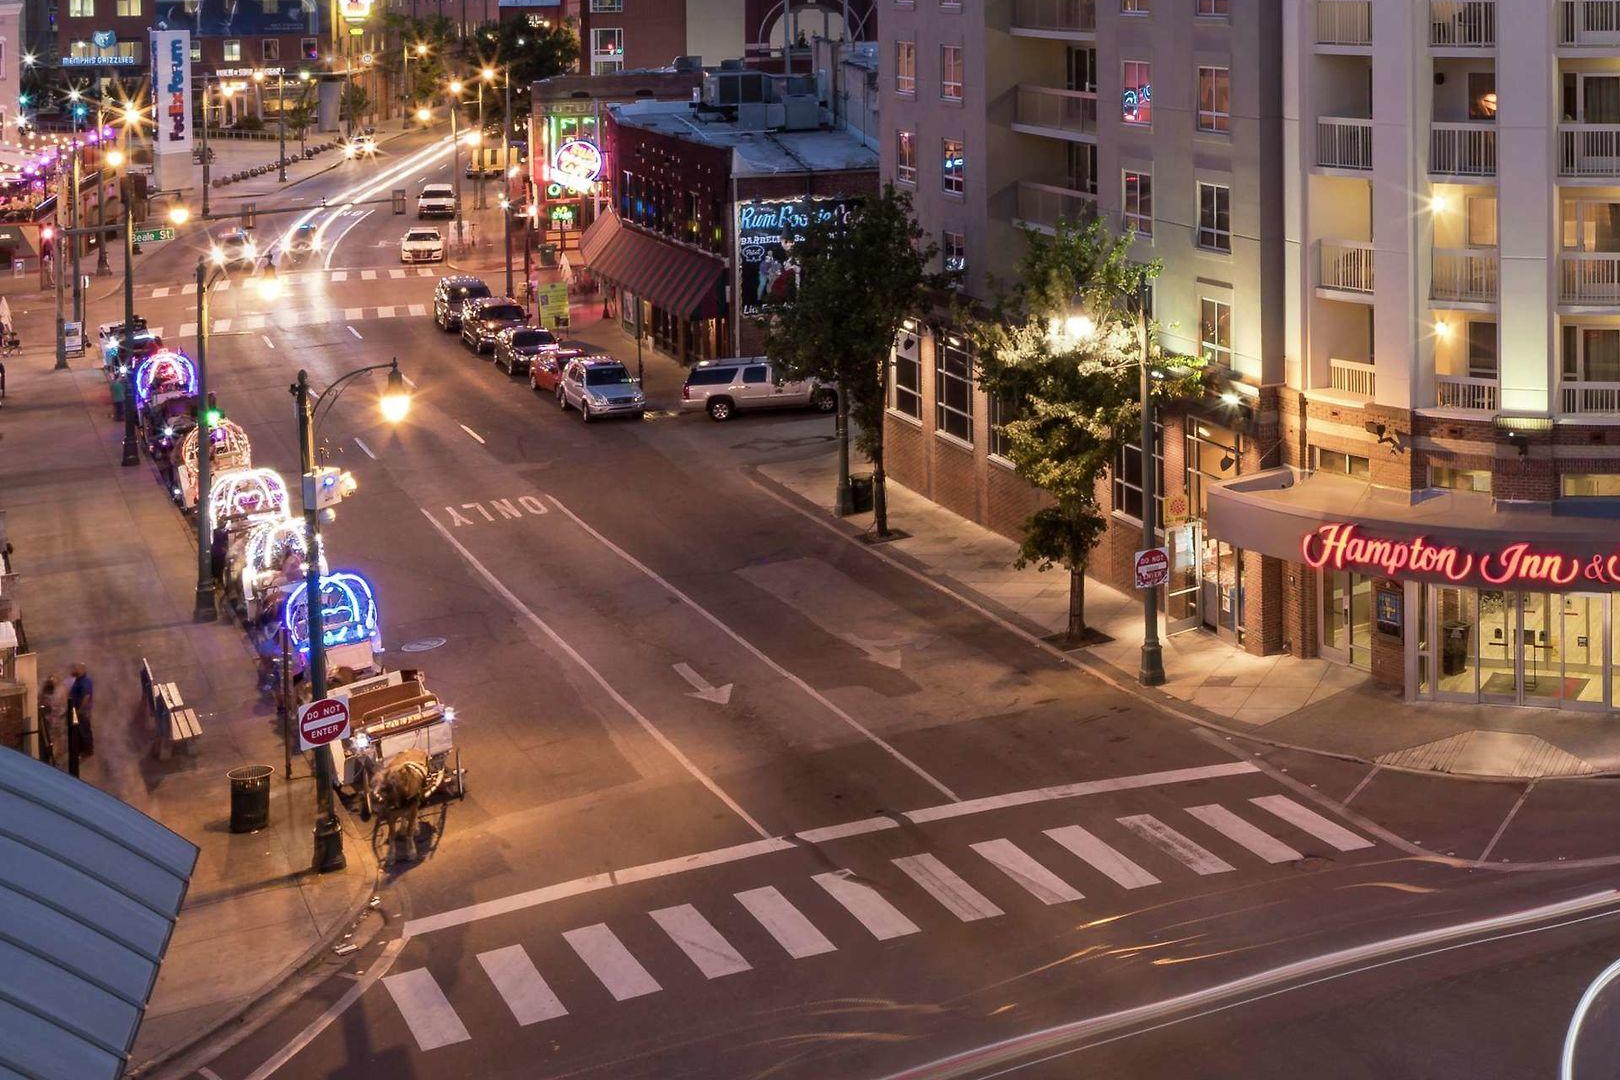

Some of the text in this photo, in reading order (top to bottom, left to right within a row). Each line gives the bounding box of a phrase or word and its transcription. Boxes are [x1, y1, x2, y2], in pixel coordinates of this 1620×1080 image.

[167, 39, 185, 141] FedExForum
[741, 207, 777, 228] Rum
[445, 495, 549, 527] ONLY
[1302, 523, 1472, 580] Hampton
[1480, 542, 1580, 584] Inn
[1584, 553, 1609, 584] &
[306, 705, 341, 720] DO NOT
[311, 726, 339, 738] ENTER
